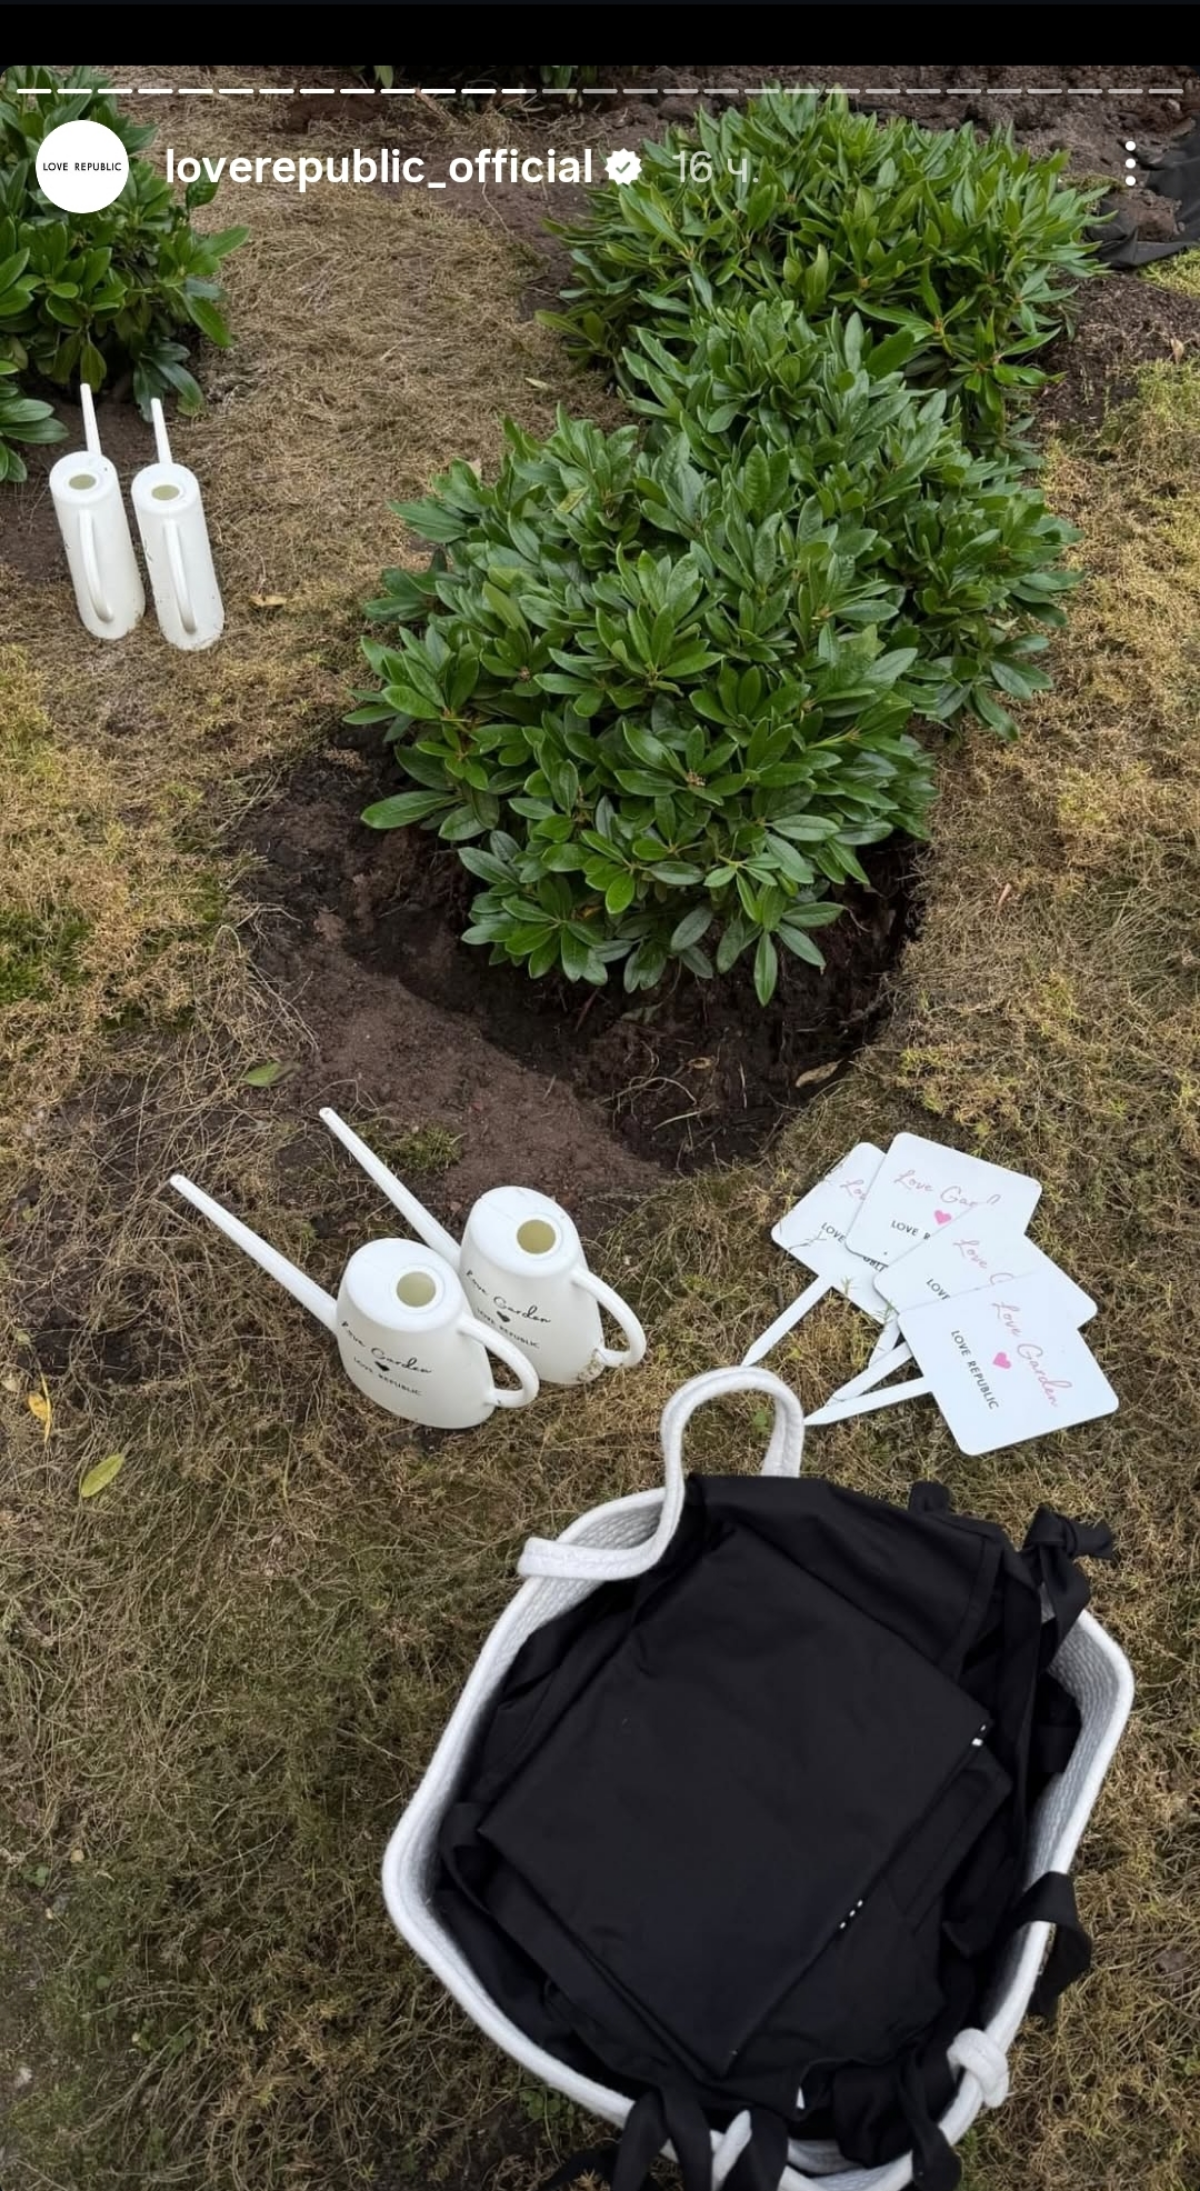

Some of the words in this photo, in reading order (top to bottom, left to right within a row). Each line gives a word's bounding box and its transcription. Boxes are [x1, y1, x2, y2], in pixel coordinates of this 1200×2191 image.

[839, 1179, 868, 1201] Lov
[892, 1169, 934, 1192] Love
[940, 1185, 1001, 1208] Gar
[821, 1222, 847, 1243] LOVE
[890, 1219, 919, 1237] LOVE
[952, 1239, 988, 1269] Love
[493, 1296, 551, 1323] Garden
[991, 1300, 1021, 1337] Love
[1016, 1343, 1073, 1407] Garden
[950, 1329, 972, 1357] LOVE
[966, 1360, 999, 1410] REPUBLIC
